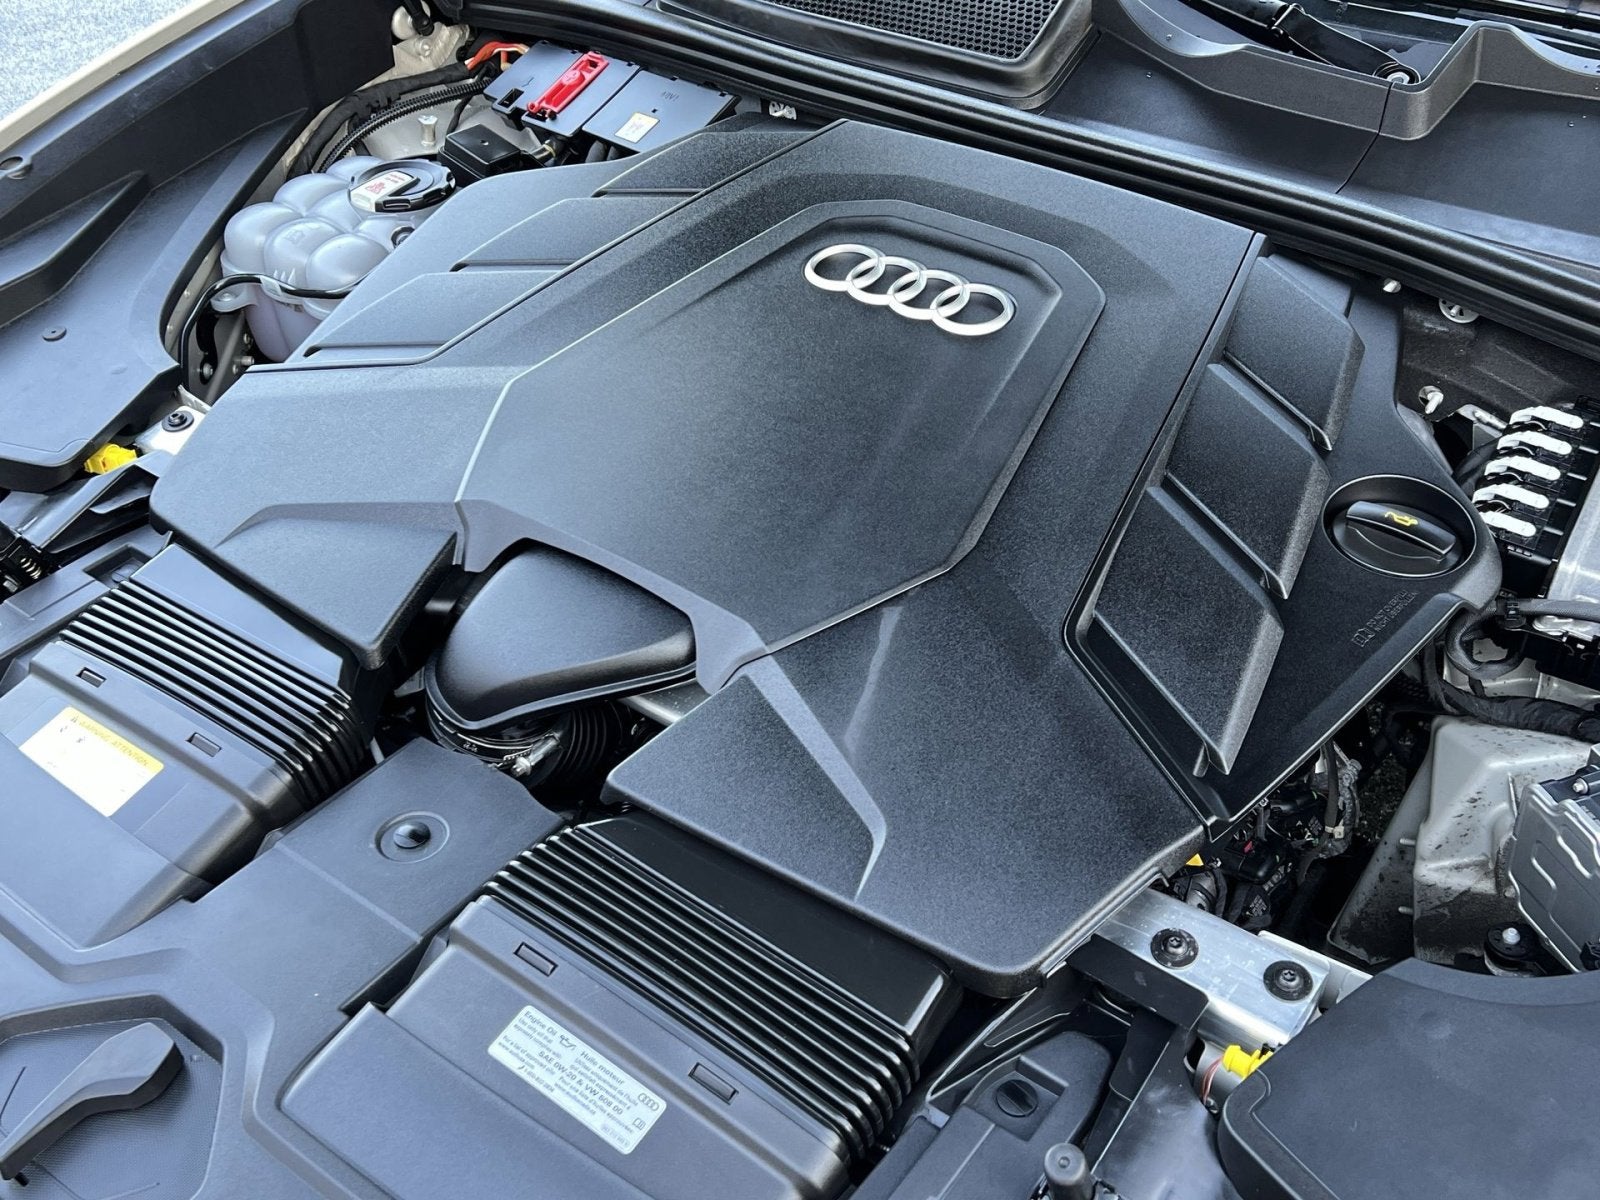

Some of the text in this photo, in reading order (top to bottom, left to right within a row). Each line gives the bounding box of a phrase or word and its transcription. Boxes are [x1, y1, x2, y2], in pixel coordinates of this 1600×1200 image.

[523, 1010, 557, 1036] Engine Oil
[538, 1050, 554, 1064] SAE
[553, 1061, 577, 1080] 0W-20
[584, 1083, 598, 1096] VW
[612, 1104, 623, 1114] 00
[580, 1050, 625, 1085] Huile moteur
